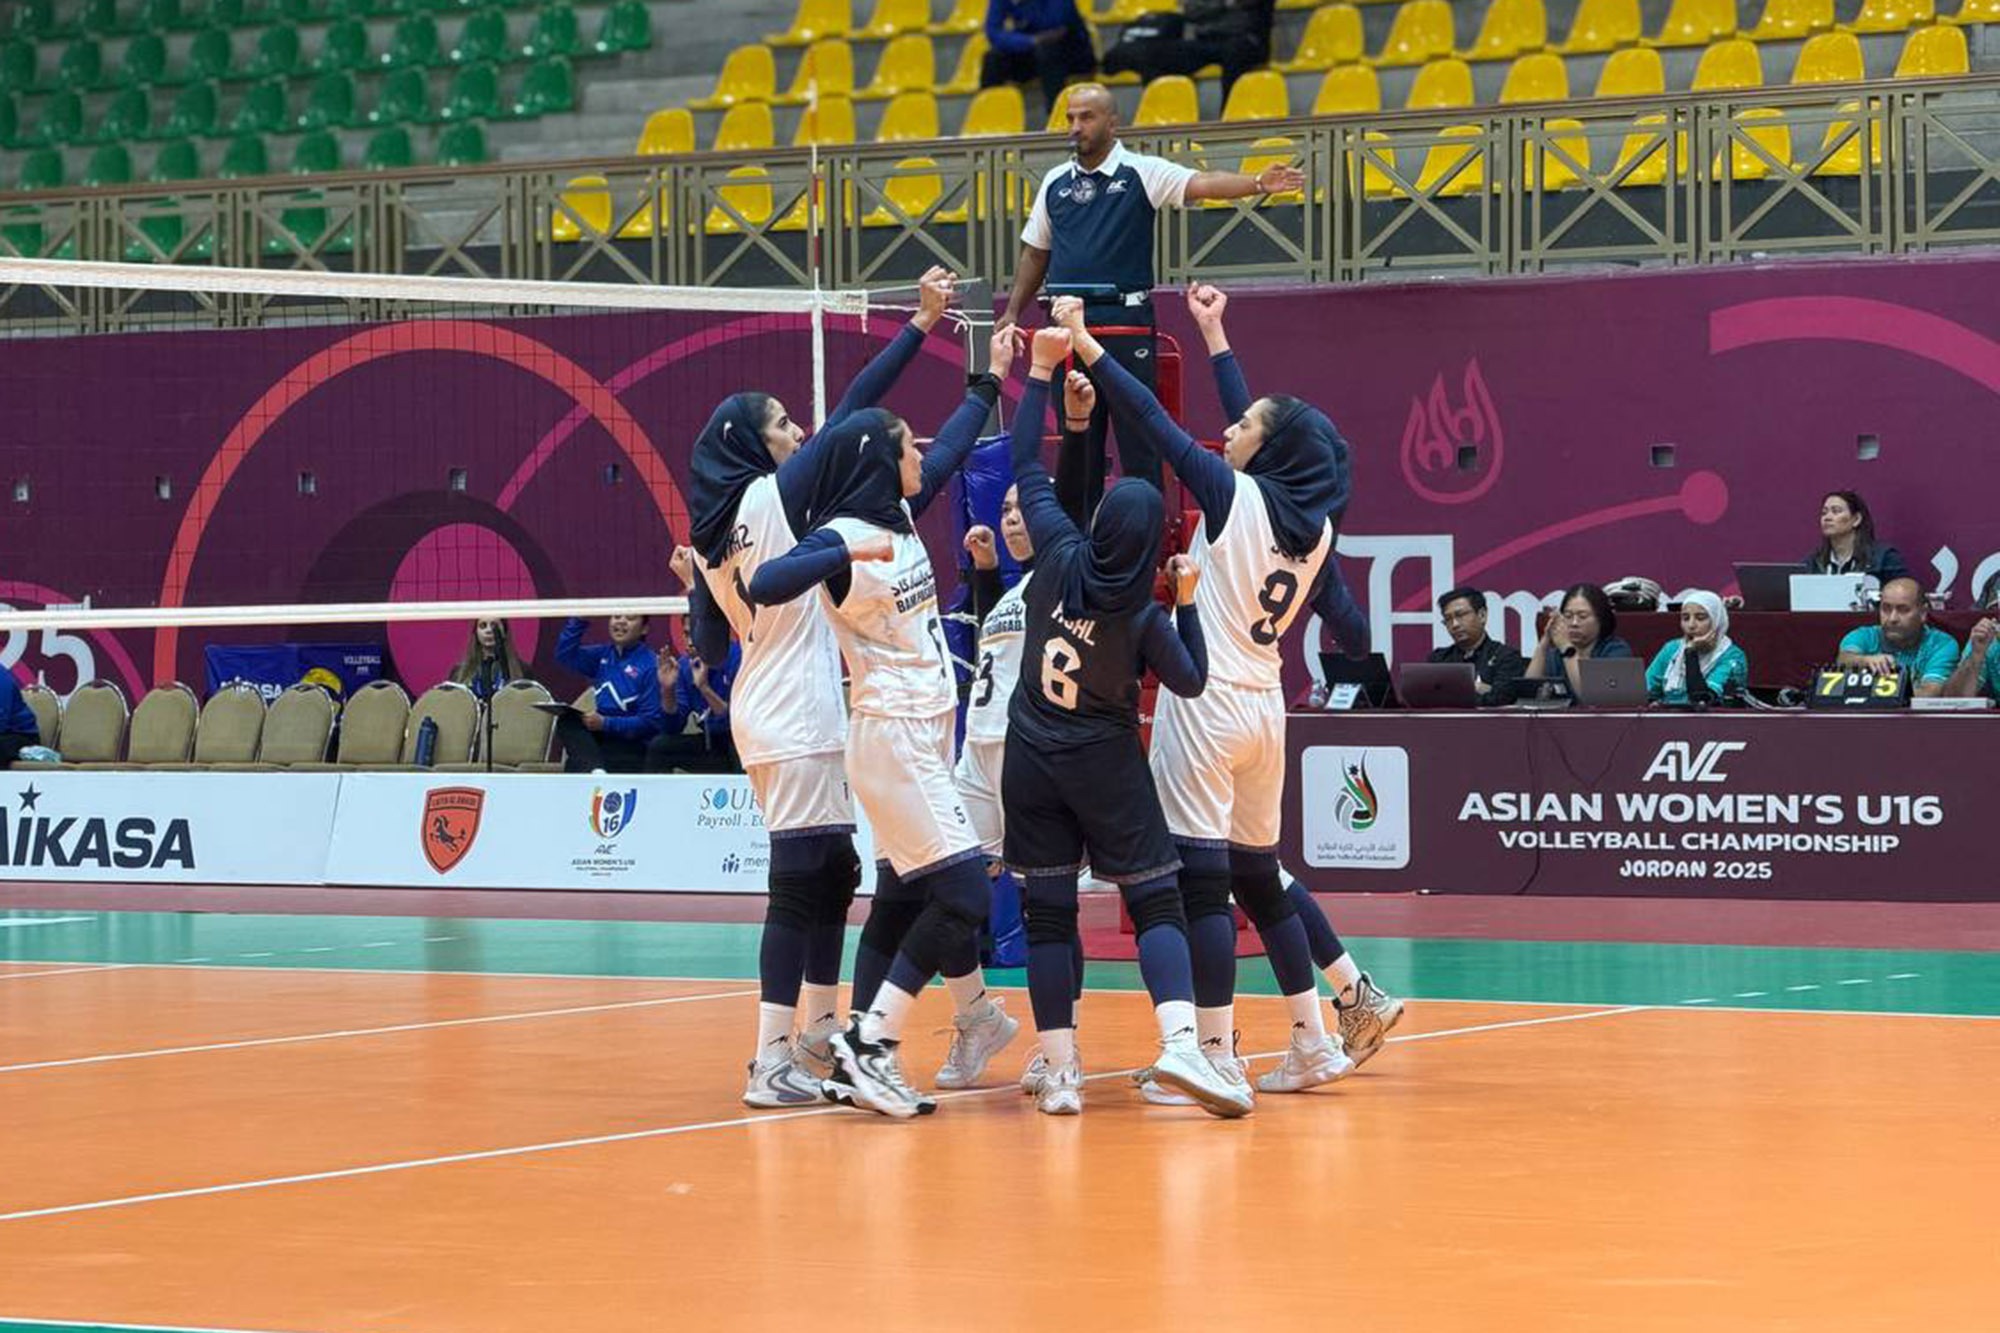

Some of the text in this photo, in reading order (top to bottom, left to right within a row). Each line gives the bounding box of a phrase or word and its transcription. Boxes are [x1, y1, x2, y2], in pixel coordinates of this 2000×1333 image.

[1250, 569, 1298, 646] 9
[1822, 673, 1844, 696] 7
[1875, 674, 1897, 696] 5
[1642, 741, 1747, 782] AVC
[697, 813, 742, 829] Payroll
[1458, 793, 1942, 825] ASIAN WOMEN'S U16
[0, 781, 196, 870] IKASA
[1499, 831, 1900, 853] VOLLEYBALL CHAMPIONSHIP
[1620, 860, 1773, 878] JORDAN 2025
